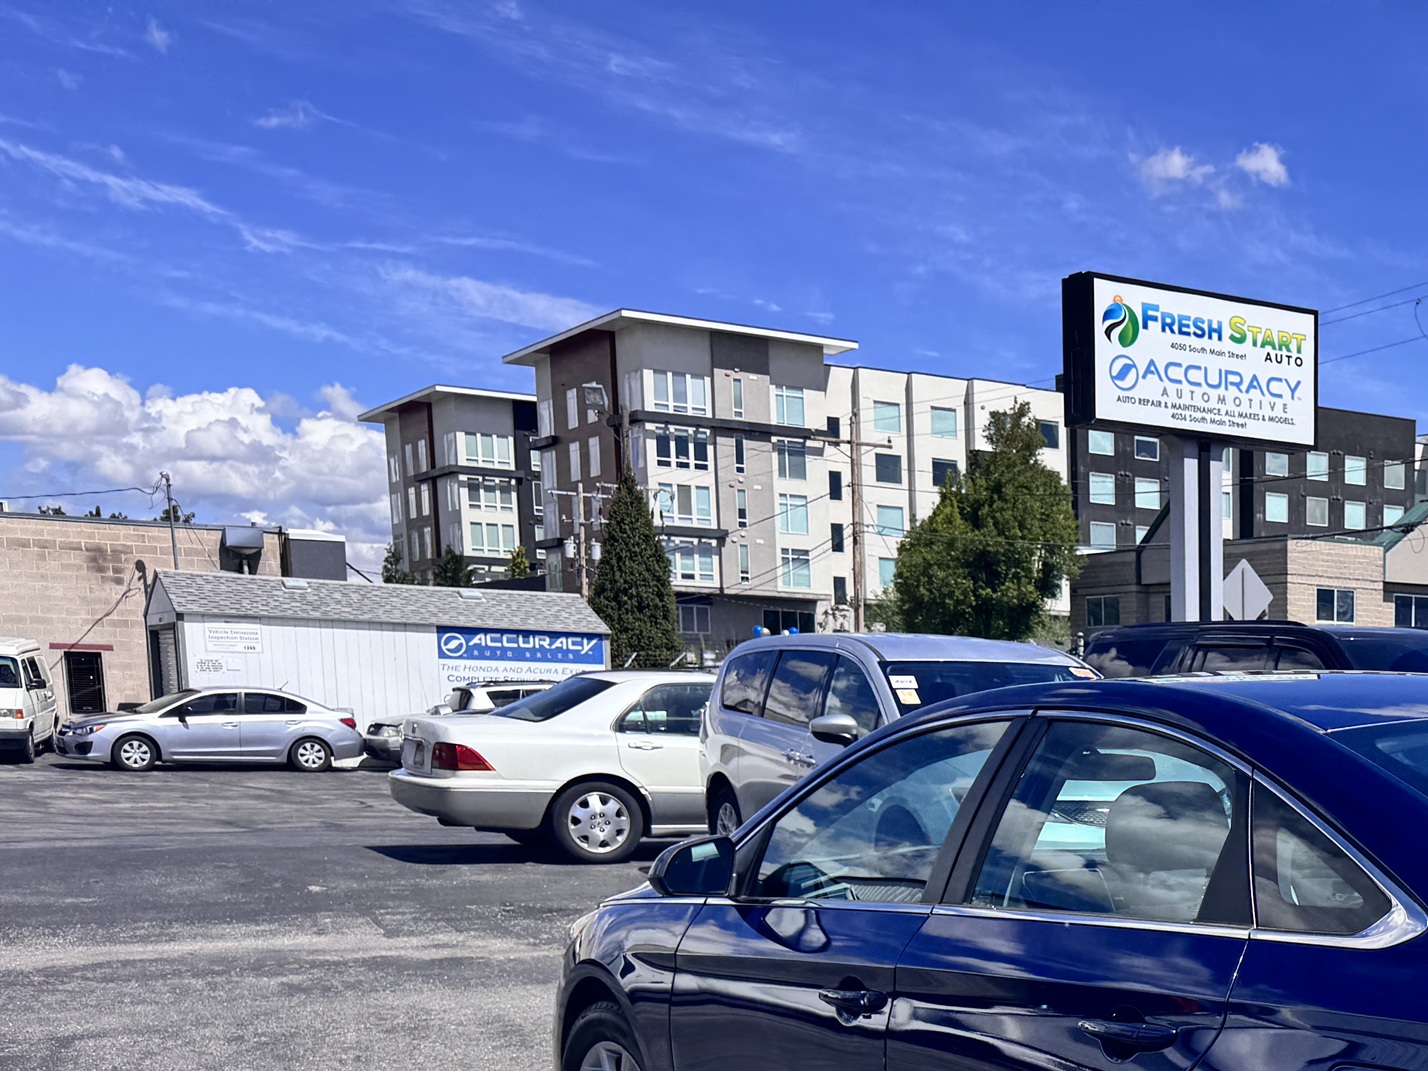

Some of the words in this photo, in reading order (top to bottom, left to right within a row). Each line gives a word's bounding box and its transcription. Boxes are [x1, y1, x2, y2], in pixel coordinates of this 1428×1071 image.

[1141, 301, 1223, 342] FRESH
[1228, 315, 1307, 355] START
[1170, 341, 1187, 352] 4050
[1188, 344, 1208, 355] South
[1208, 347, 1226, 358] Main
[1227, 350, 1247, 361] Street
[1264, 351, 1304, 368] AUTO
[1141, 358, 1301, 401] ACCURACY
[1116, 394, 1136, 405] AUTO
[1137, 397, 1162, 408] REPAIR
[1163, 401, 1169, 409] &
[1224, 409, 1236, 418] ALL
[1237, 410, 1260, 421] MAKES
[1261, 414, 1267, 422] &
[1267, 414, 1296, 426] MODELS.
[1160, 386, 1289, 414] AUTOMOTIVE
[1170, 411, 1188, 422] 4036
[1188, 414, 1209, 425] South
[1208, 416, 1227, 427] Main
[1227, 419, 1247, 429] Street
[468, 632, 600, 655] ACCURACY
[473, 649, 513, 658] AUTO
[525, 651, 574, 660] SALES
[440, 663, 461, 672] THE
[463, 664, 500, 673] HONDA
[501, 666, 523, 674] AND
[525, 666, 559, 675] ACURA
